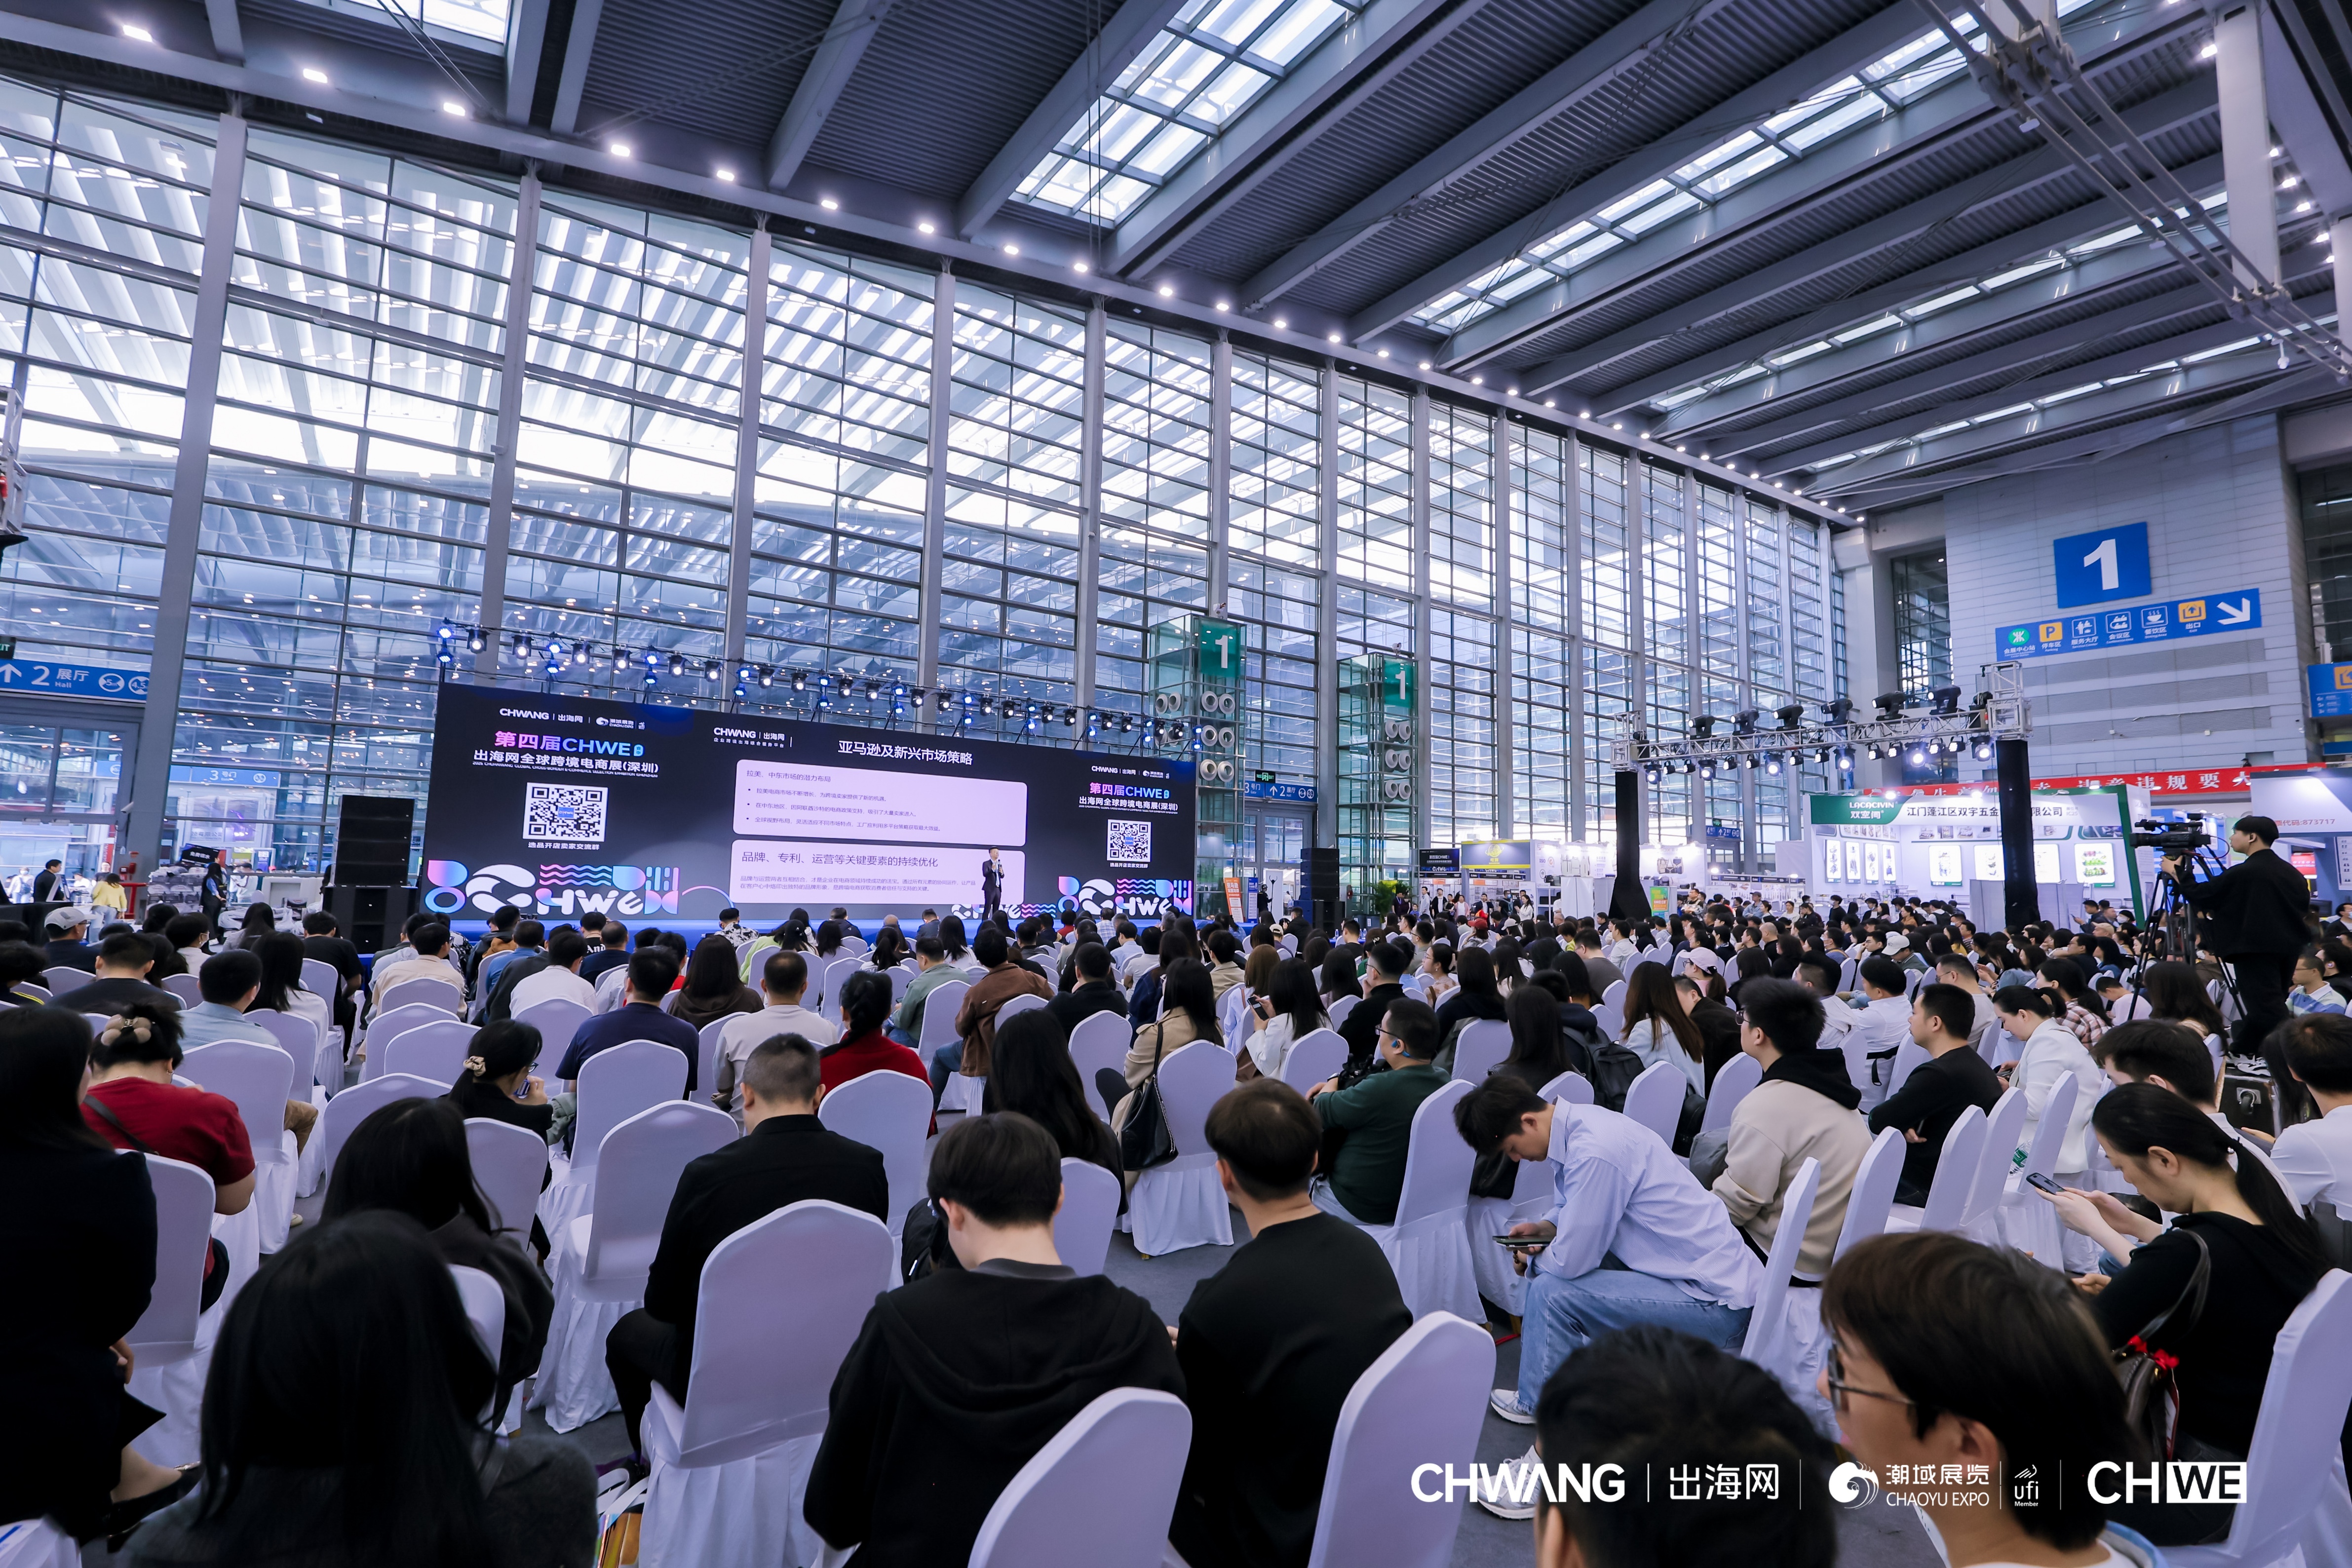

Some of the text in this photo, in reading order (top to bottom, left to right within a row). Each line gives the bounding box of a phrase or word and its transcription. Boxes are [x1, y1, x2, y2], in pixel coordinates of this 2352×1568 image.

[2083, 538, 2120, 591] 1
[2045, 626, 2056, 639] P
[2109, 632, 2130, 640] 会议区
[2144, 626, 2167, 635] 餐饮区
[2071, 636, 2098, 646] 服务大厅
[1215, 635, 1228, 669] 1
[2004, 645, 2036, 654] 会展中心站
[31, 665, 89, 686] 2 展厅
[1395, 671, 1406, 700] 1
[500, 708, 549, 720] CHWANG
[558, 714, 583, 723] 出海网
[714, 727, 756, 738] CHWANG
[764, 732, 785, 741] 出海网
[494, 730, 631, 757] 第四届CHWE
[838, 740, 973, 765] 亚马逊及新兴市场策略
[473, 749, 659, 773] 出海网全球跨境电商展(深圳)
[209, 770, 219, 781] 3
[747, 770, 831, 782] 拉美、中东市场的潜力布局
[1089, 782, 1162, 799] 第四届CHWE
[1279, 786, 1285, 797] 2
[1079, 796, 1178, 811] 出海网全球跨境电商展(深圳)
[1851, 810, 1881, 819] 双空间
[528, 841, 600, 850] 选品开店卖家交流群
[742, 851, 938, 867] 品牌、专利、运营等关键要素的持续优化
